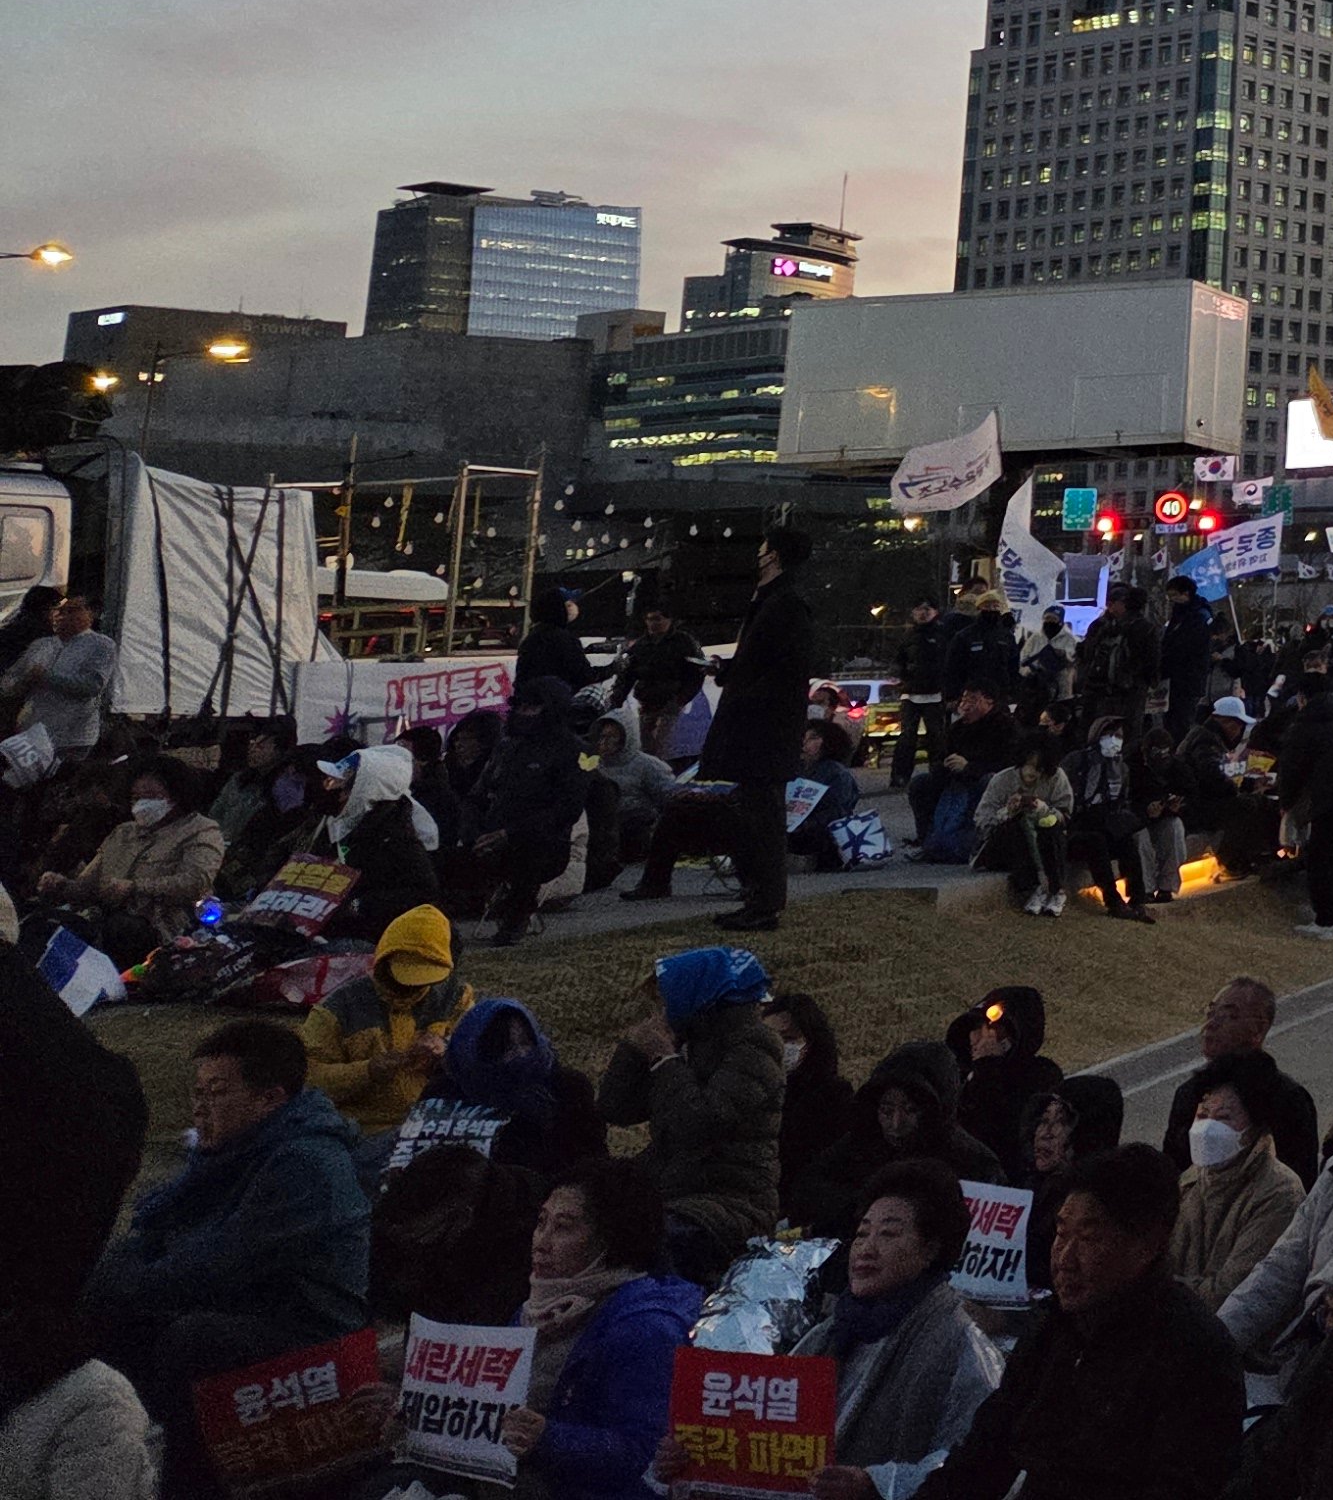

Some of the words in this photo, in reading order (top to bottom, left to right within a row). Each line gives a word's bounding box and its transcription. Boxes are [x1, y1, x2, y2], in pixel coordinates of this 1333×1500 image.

[1162, 501, 1180, 516] 40
[406, 1337, 523, 1391] 내란세력
[233, 1360, 341, 1428] 윤석열
[702, 1371, 799, 1423] 윤석열
[674, 1423, 740, 1472] 즉각
[747, 1431, 827, 1479] 파면!
